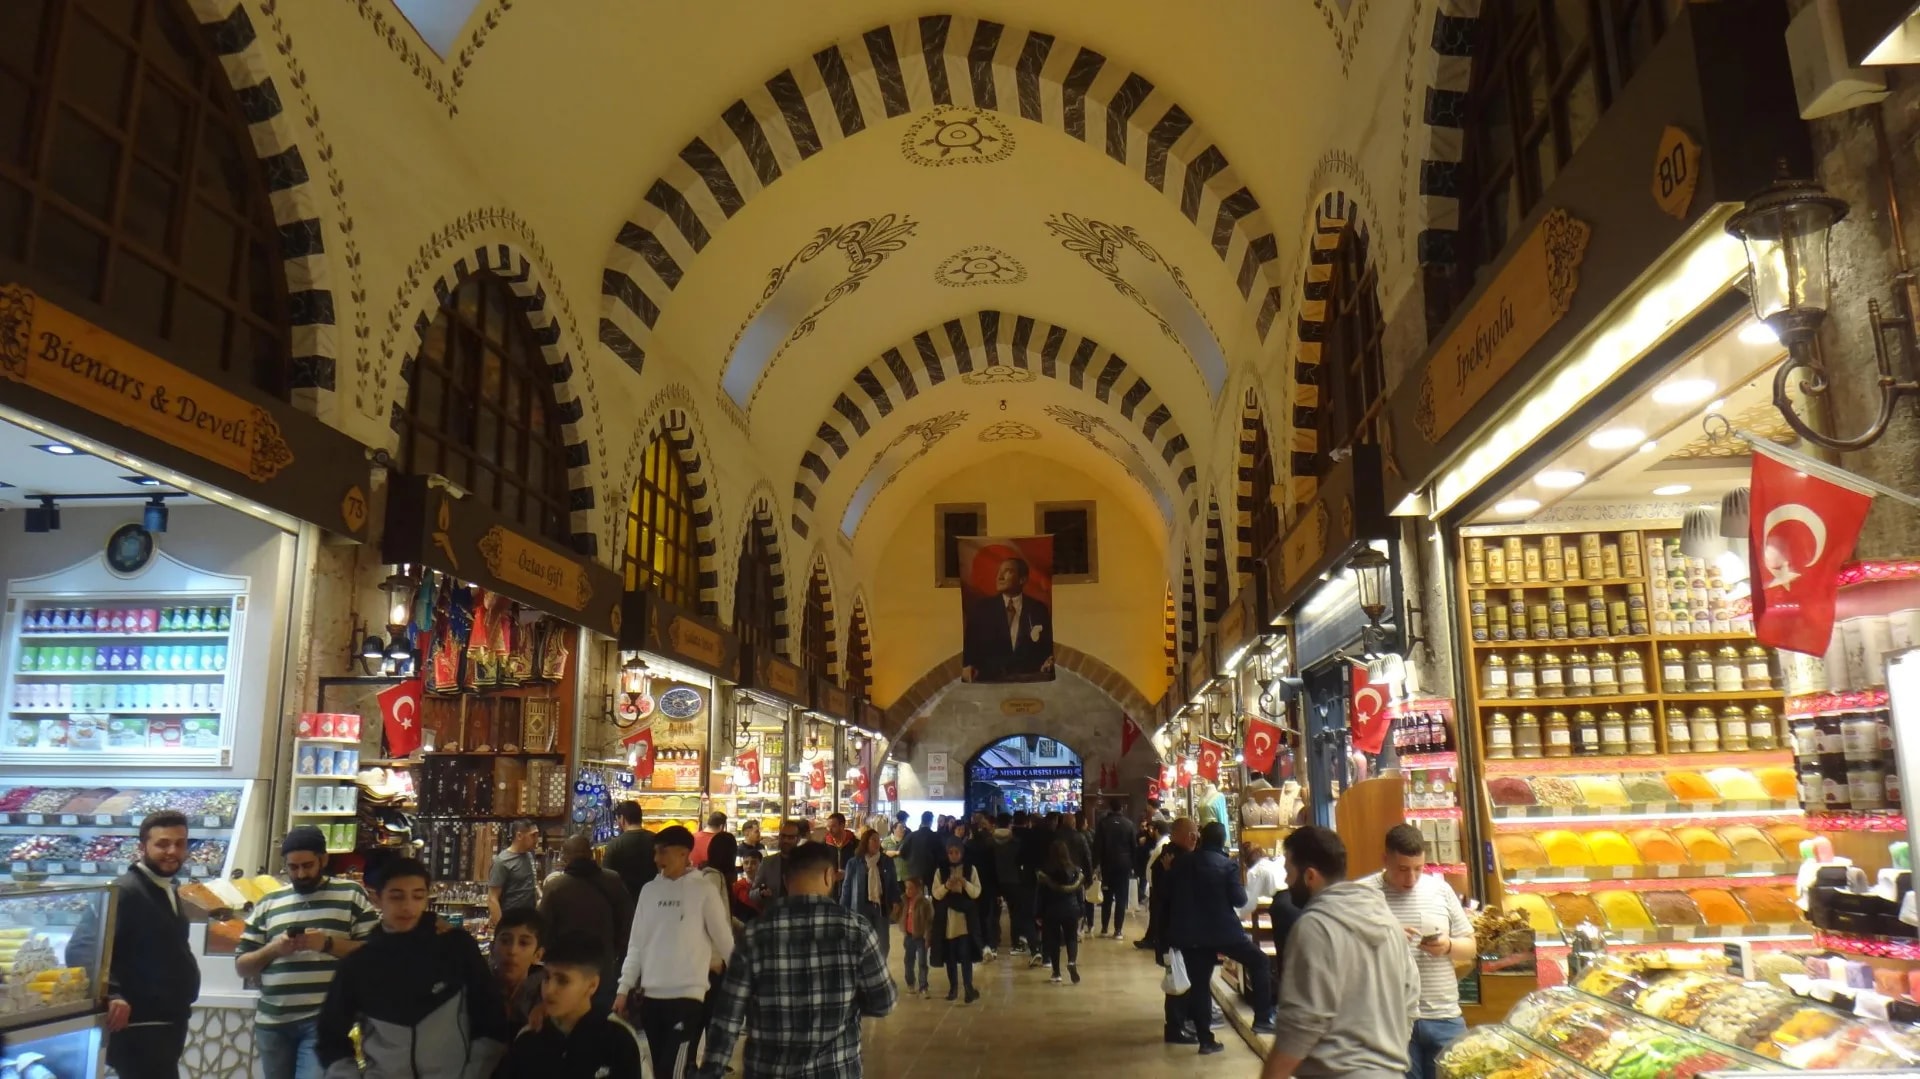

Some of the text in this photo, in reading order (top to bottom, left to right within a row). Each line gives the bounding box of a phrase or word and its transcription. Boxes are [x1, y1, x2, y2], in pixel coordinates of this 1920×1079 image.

[1658, 141, 1688, 199] 80
[1456, 295, 1515, 397] İpekyolu
[38, 331, 249, 449] Bienars & Develi
[657, 900, 681, 908] PARIS
